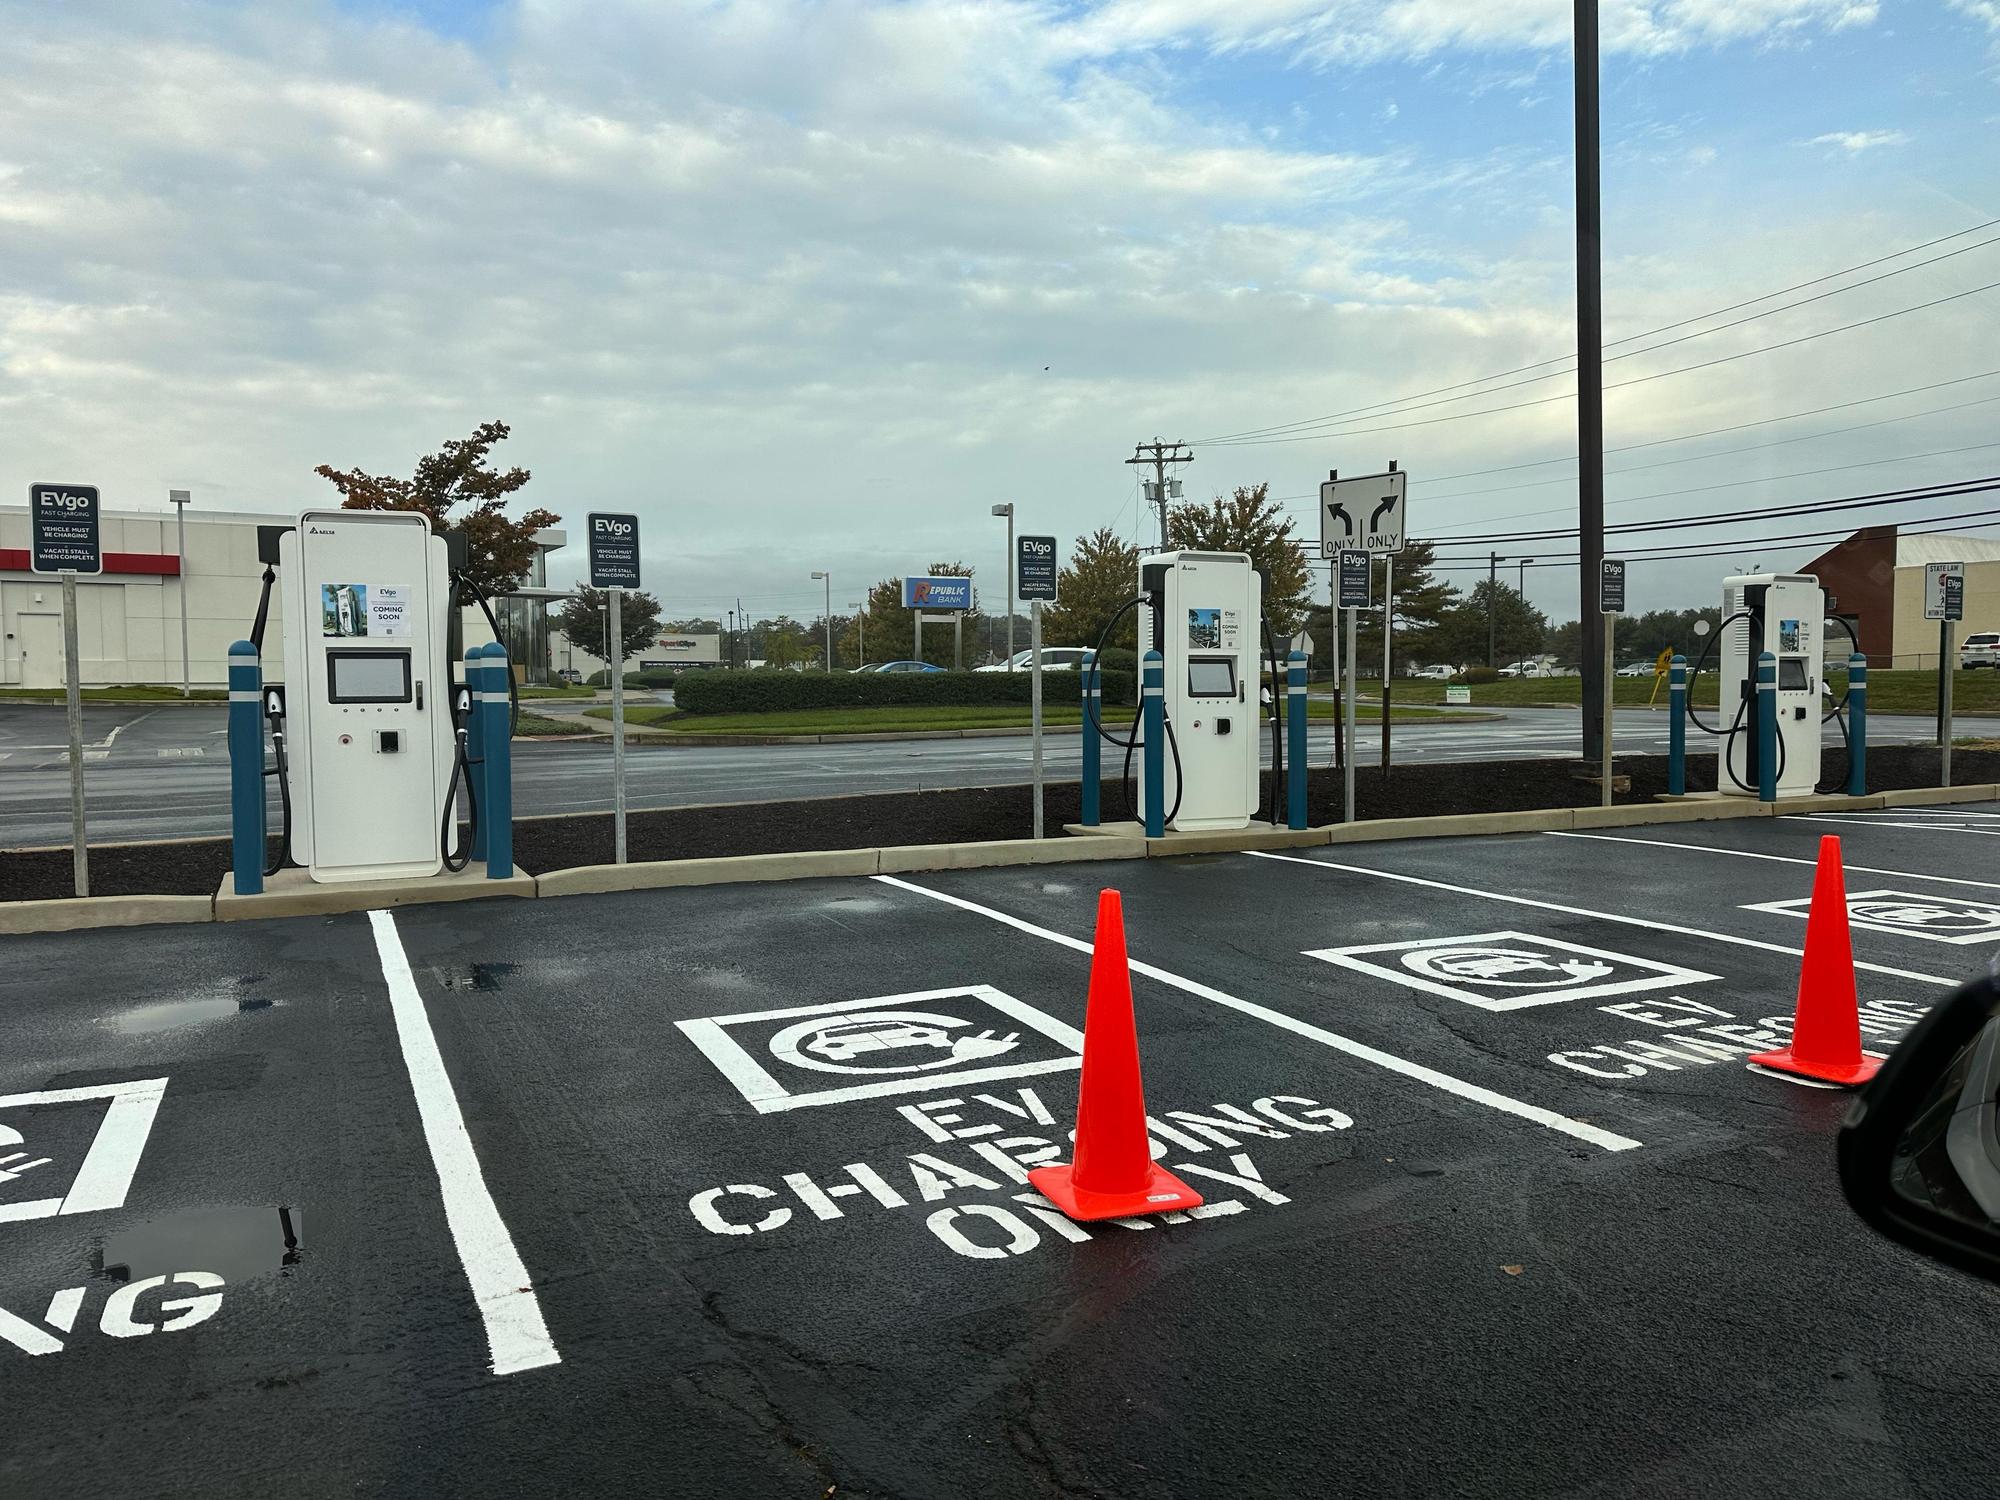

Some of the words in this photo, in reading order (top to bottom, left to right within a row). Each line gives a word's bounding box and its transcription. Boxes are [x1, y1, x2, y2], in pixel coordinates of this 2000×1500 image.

[40, 492, 89, 510] EVgo
[595, 520, 631, 535] EVgo
[1023, 541, 1051, 554] EVgo
[1368, 533, 1398, 548] ONLY
[1344, 555, 1366, 567] EVgo
[1604, 564, 1622, 575] EVgo
[1947, 579, 1961, 589] EVgo
[912, 582, 965, 603] REPUBLIC
[1596, 996, 1736, 1028] EV
[1547, 1000, 1933, 1079] CHARNG
[896, 1088, 1055, 1143] EV
[689, 1095, 1354, 1236] CHARING
